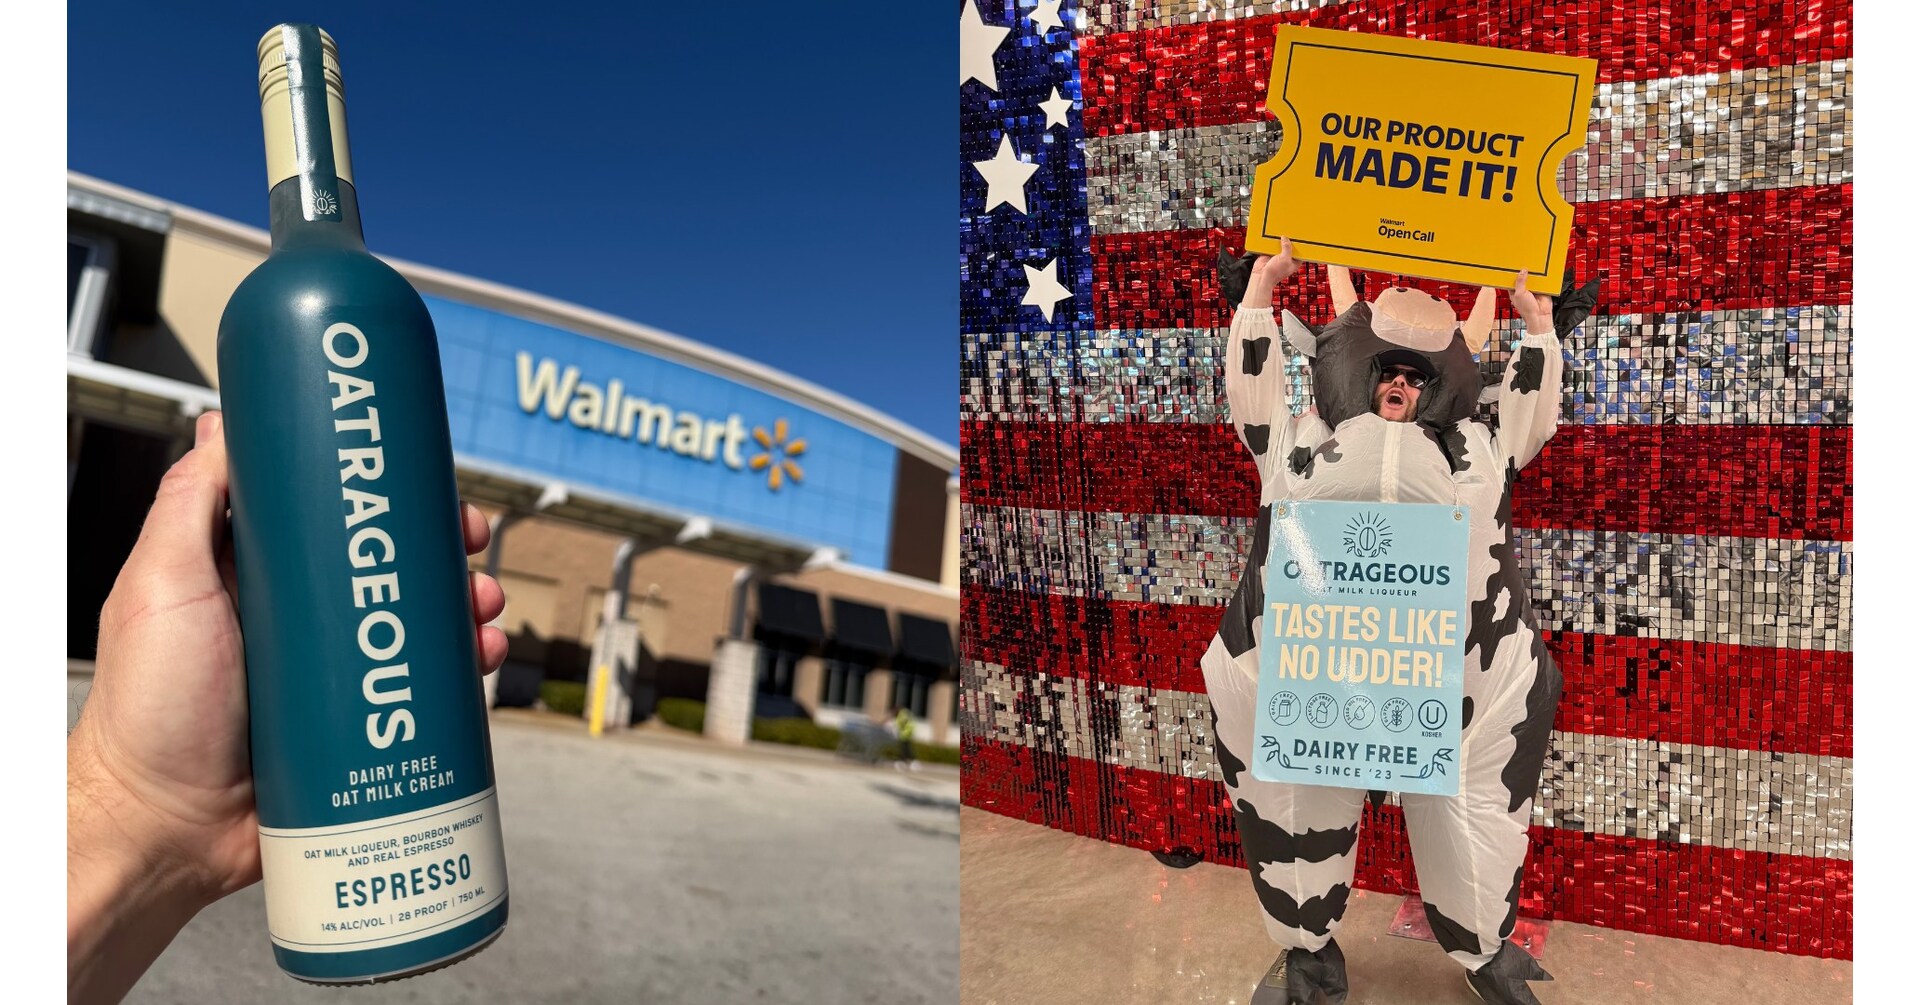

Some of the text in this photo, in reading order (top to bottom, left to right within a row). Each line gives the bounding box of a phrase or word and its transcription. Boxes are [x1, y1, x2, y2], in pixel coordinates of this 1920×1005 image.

[1320, 112, 1525, 158] OUR PRODUCT
[1314, 142, 1518, 203] MADE IT!
[1378, 225, 1435, 243] Open Call
[1379, 218, 1405, 227] Walmart
[515, 351, 746, 470] Walmart
[322, 322, 416, 750] OATRAGEOUS
[1283, 560, 1450, 586] OTRAGEOUS
[1338, 586, 1364, 595] MILK
[1369, 588, 1417, 597] LIQUEUR
[1271, 602, 1457, 647] TASTES LIKE
[1278, 643, 1444, 688] NO UDDER!
[349, 755, 438, 786] DAIRY FREE
[1293, 738, 1418, 765] DAIRY FREE
[1315, 764, 1361, 778] SINCE
[331, 770, 455, 808] OAT MILK CREAM
[304, 813, 484, 859] OAT MILK LIQUEUR, BOURBON WHISKEY
[347, 836, 455, 867] AND REAL ESPRESSO
[335, 853, 471, 908] ESPRESSO
[321, 886, 485, 932] 14% ALC/VOL 28 PROOF 750 ML
